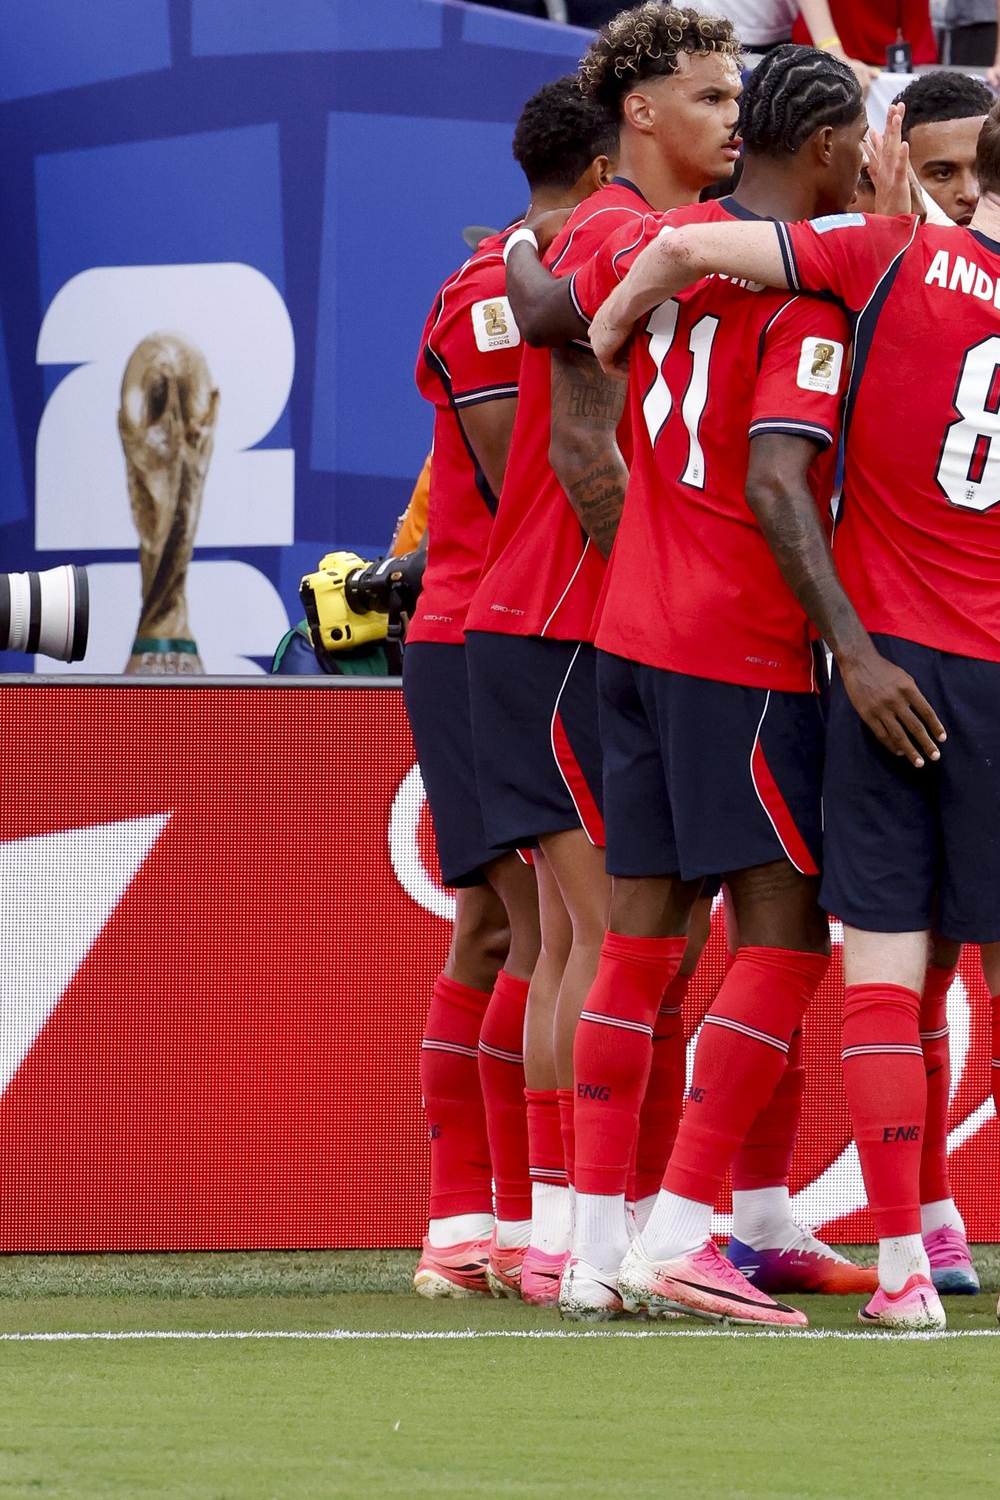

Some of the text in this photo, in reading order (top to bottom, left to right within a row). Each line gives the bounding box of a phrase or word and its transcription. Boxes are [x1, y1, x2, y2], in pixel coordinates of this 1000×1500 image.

[642, 298, 721, 491] 11
[577, 1083, 611, 1101] ENG
[686, 1086, 707, 1103] NG
[883, 1126, 921, 1143] ENG
